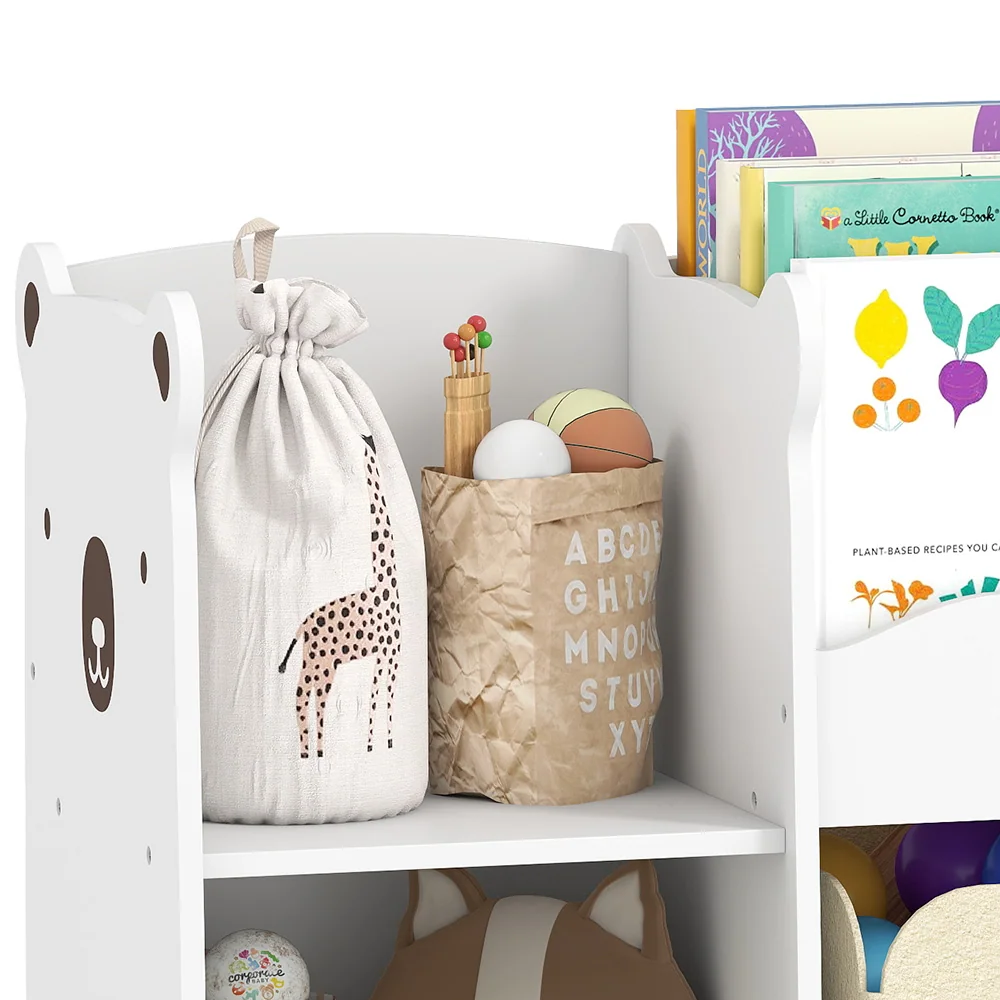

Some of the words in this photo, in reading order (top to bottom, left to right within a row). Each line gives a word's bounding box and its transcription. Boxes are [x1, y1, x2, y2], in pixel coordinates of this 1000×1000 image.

[854, 209, 890, 226] Little
[892, 207, 958, 226] Cornetto
[853, 546, 920, 556] PLANT-BASED
[923, 544, 964, 554] RECIPES
[967, 543, 988, 552] YOU
